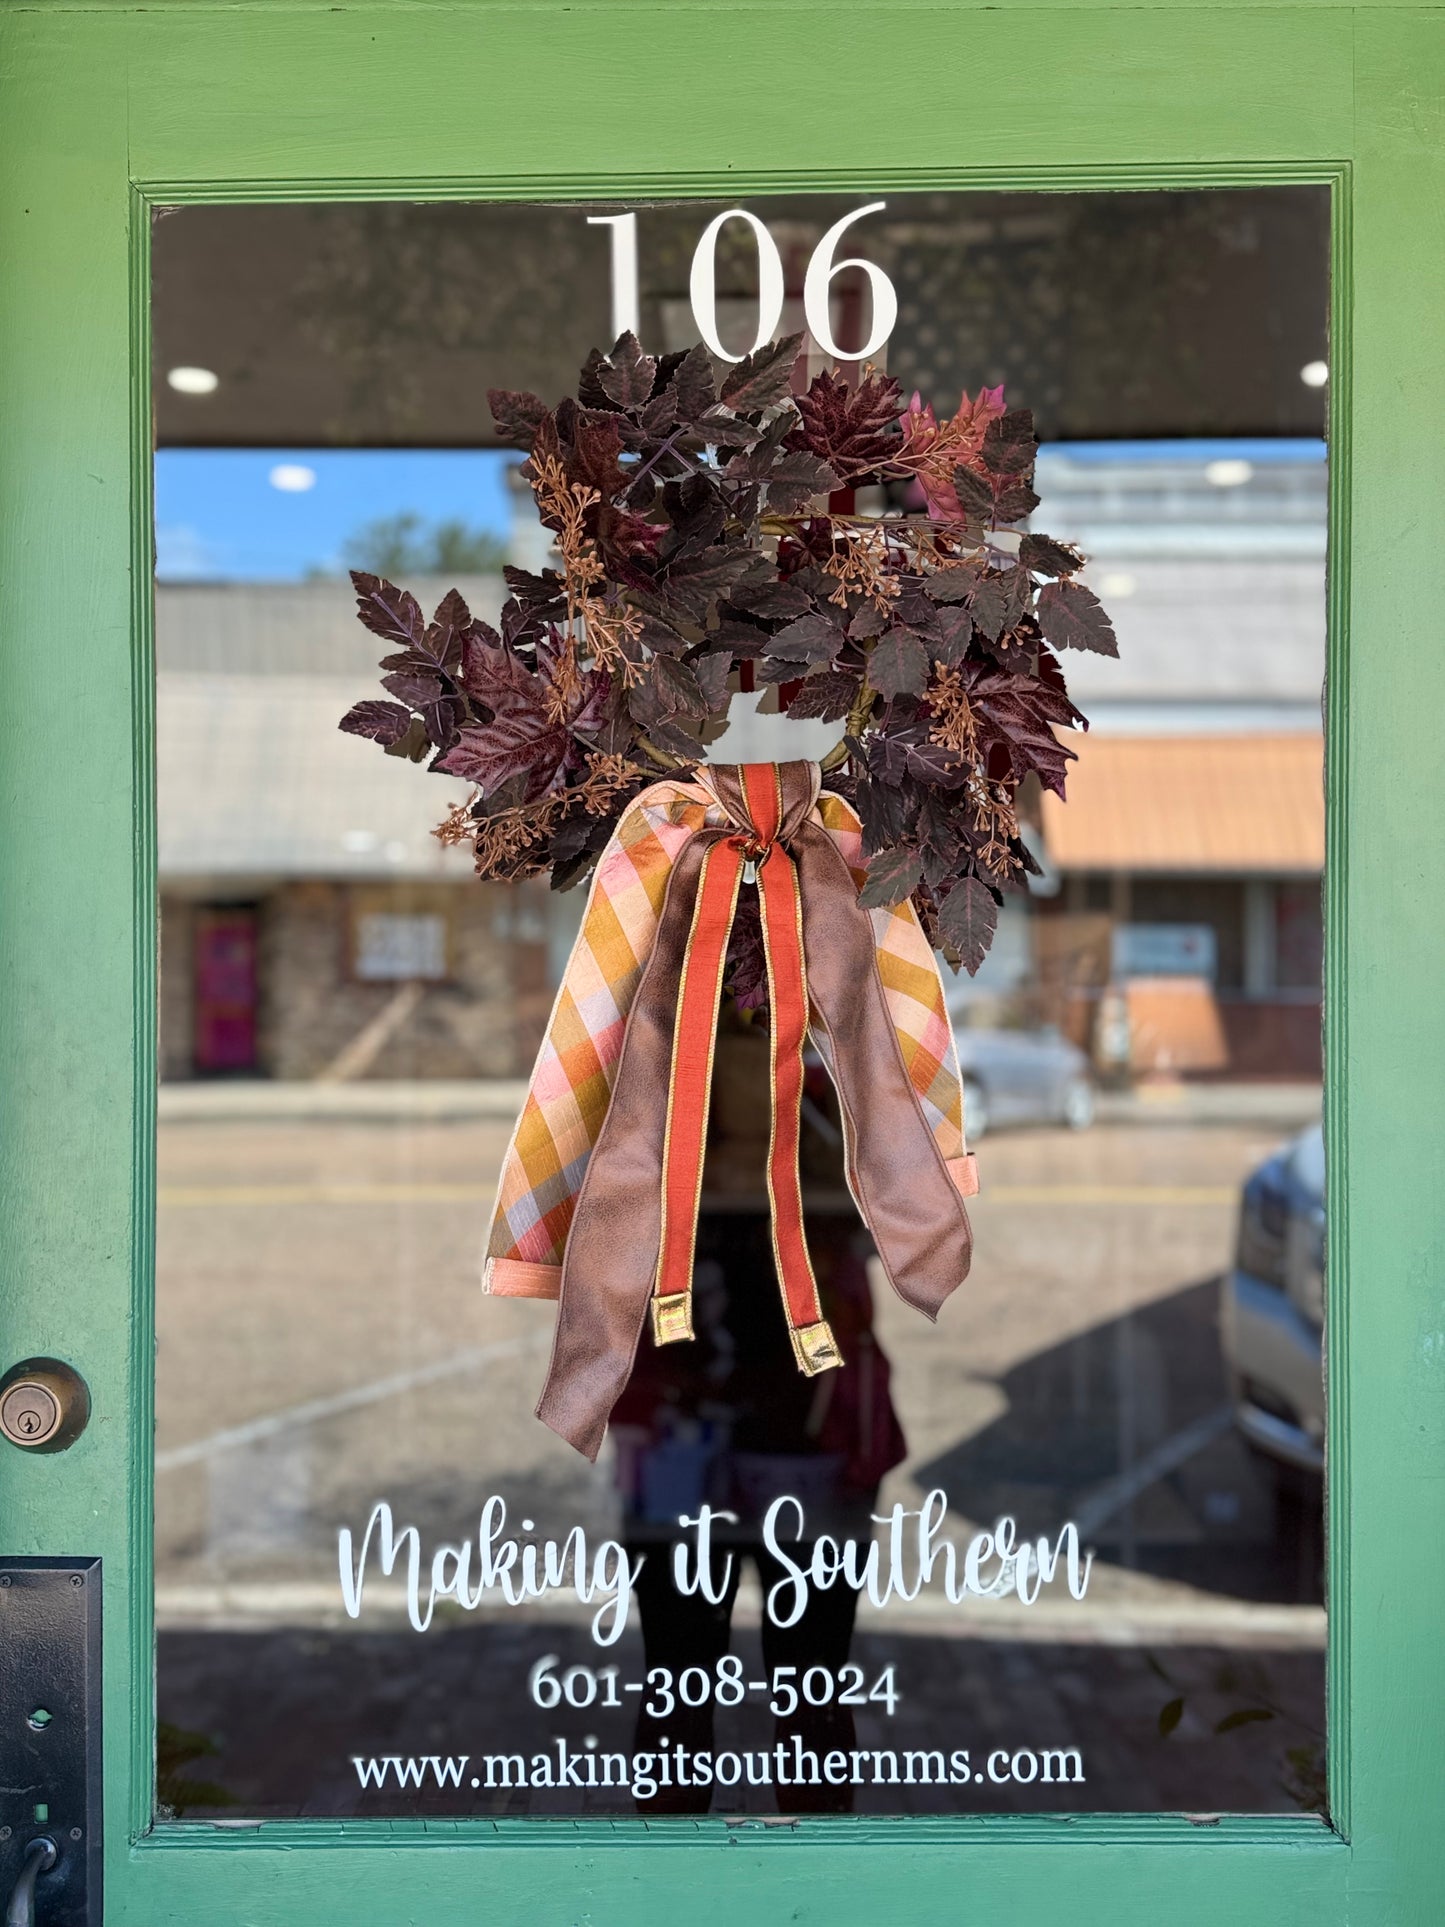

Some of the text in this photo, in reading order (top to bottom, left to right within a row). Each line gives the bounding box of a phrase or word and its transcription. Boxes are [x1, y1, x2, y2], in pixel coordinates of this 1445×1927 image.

[586, 201, 898, 363] 106
[338, 1489, 1096, 1646] Making it Southern
[531, 1655, 900, 1717] 601-308-5024
[352, 1735, 1086, 1799] www.makingitsouthernms.com
